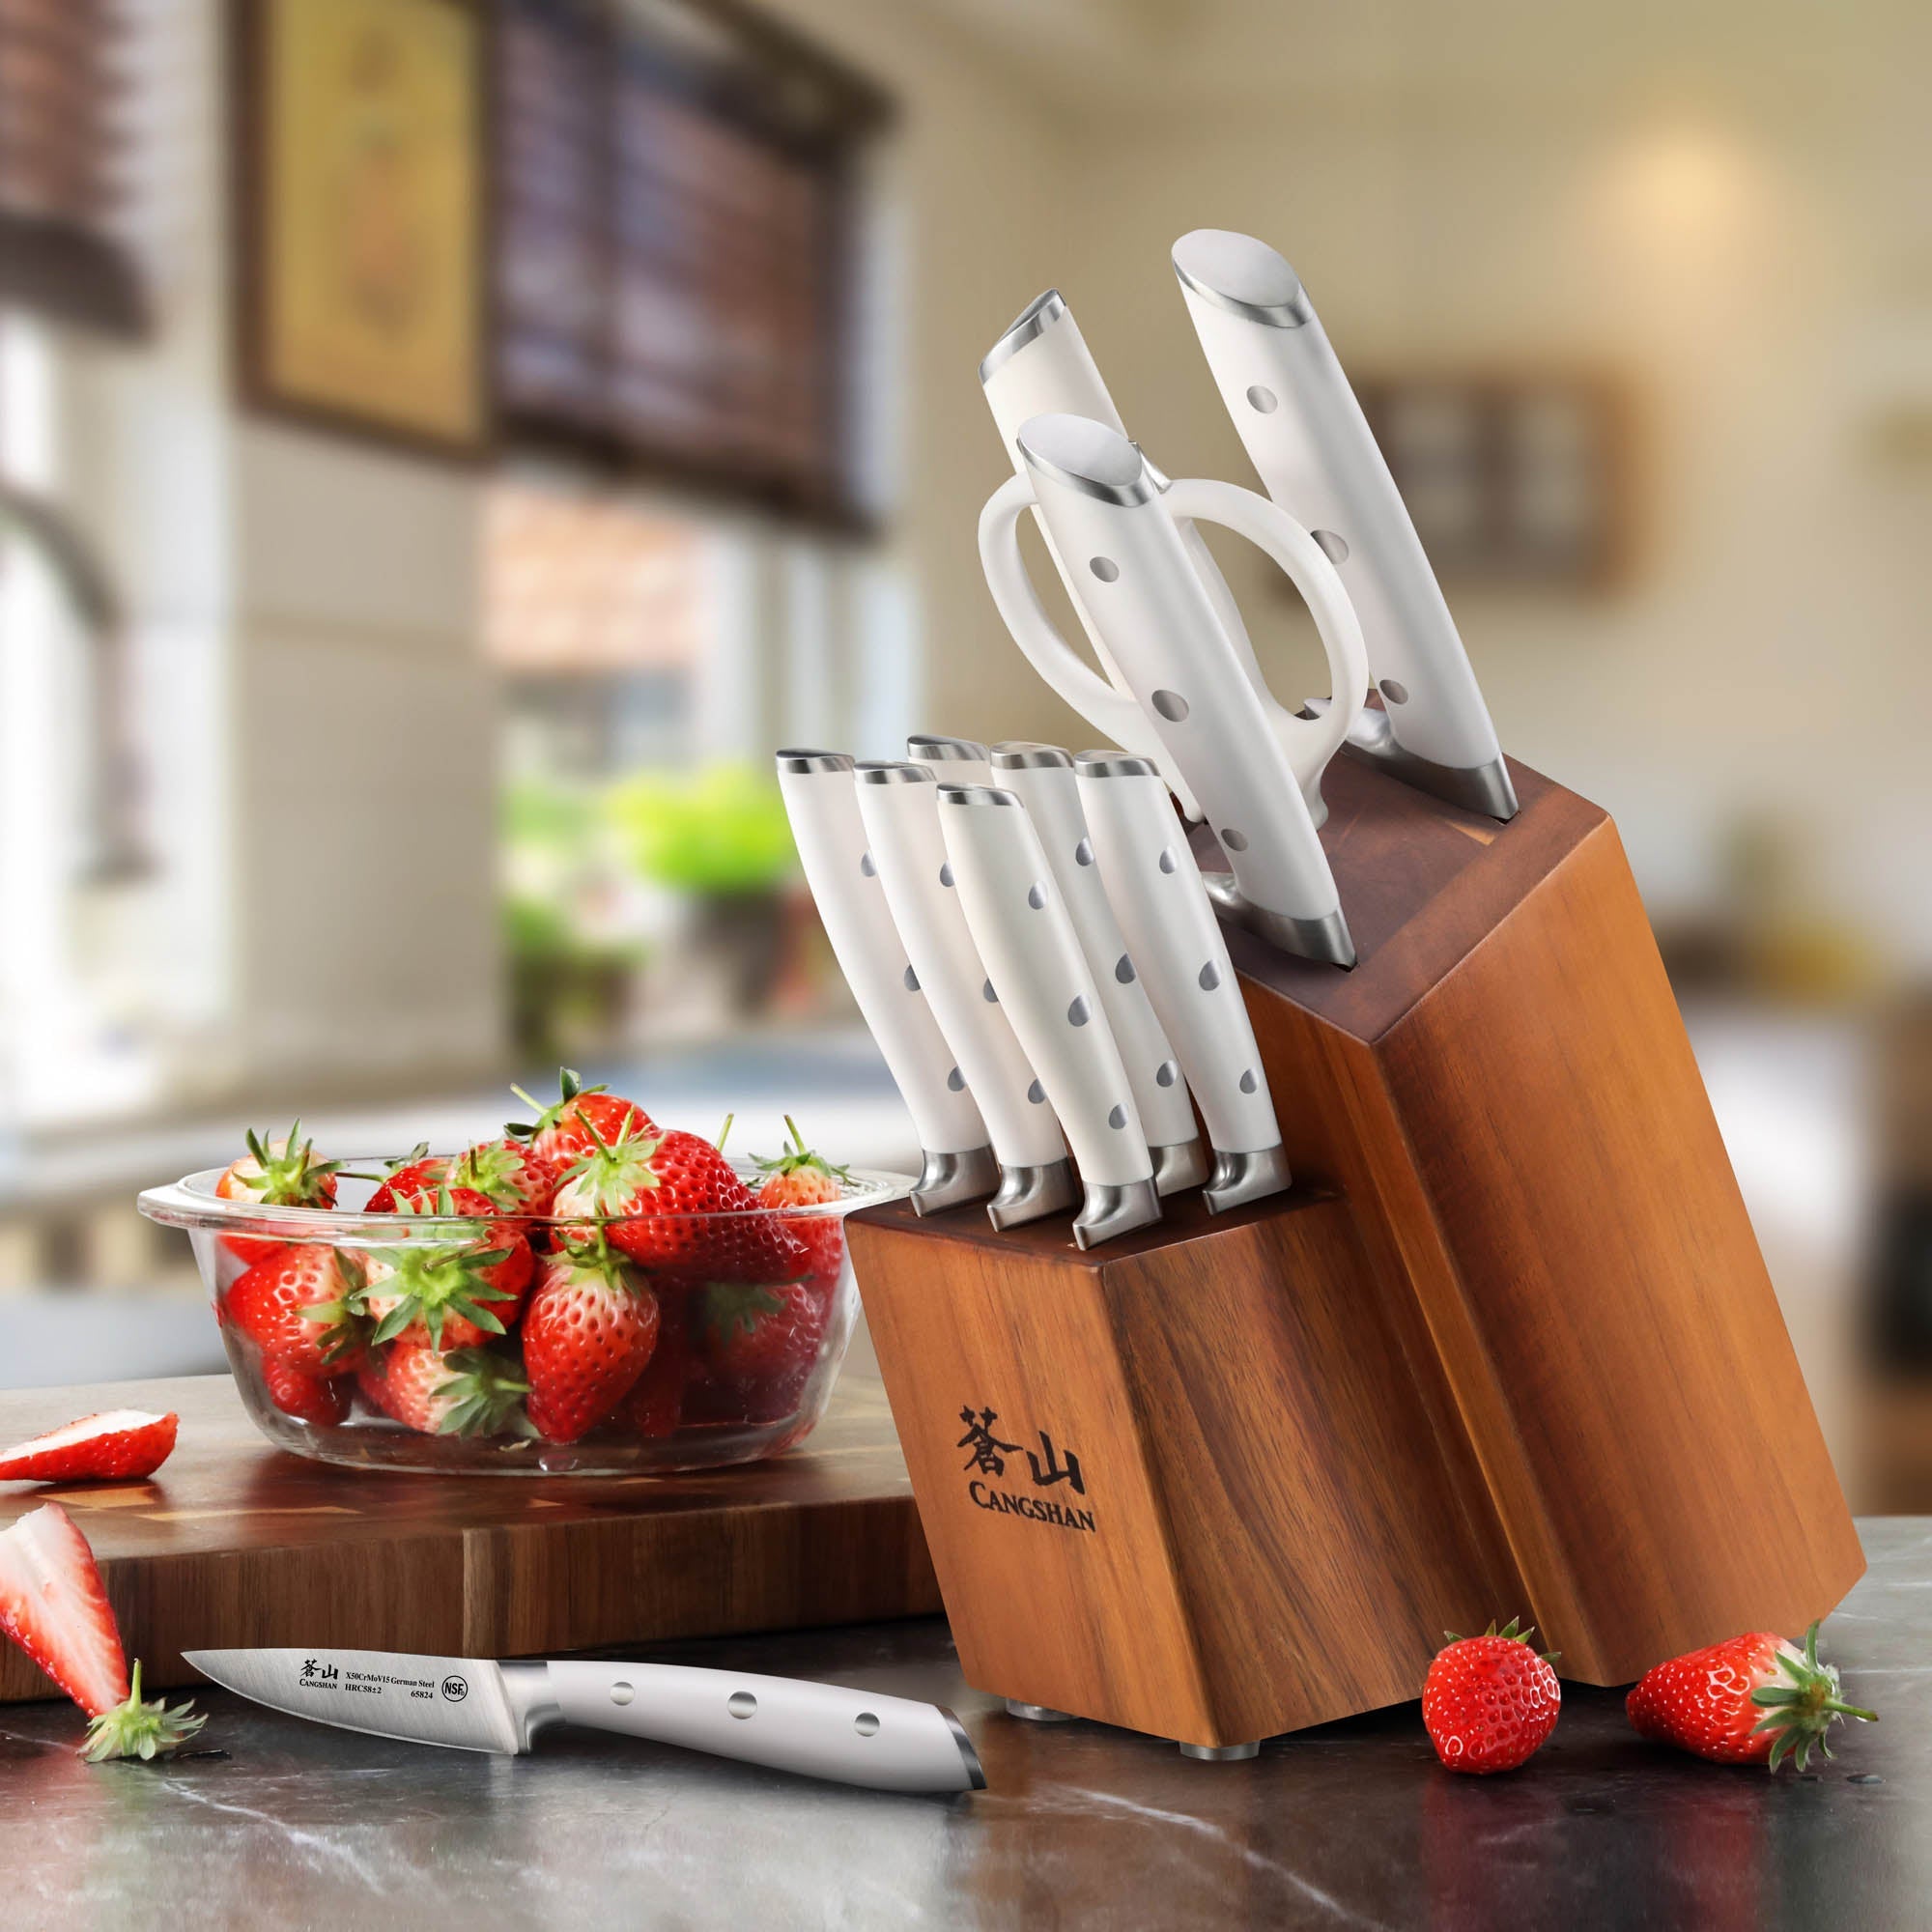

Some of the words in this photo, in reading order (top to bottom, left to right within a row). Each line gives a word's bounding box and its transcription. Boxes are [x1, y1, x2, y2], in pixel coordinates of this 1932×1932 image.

[969, 1480, 1096, 1533] CANGSHAN
[299, 1678, 337, 1690] CANGSHAN
[346, 1671, 390, 1684] X50CrMoV15
[390, 1676, 417, 1687] German
[418, 1679, 435, 1689] Steel
[345, 1683, 382, 1694] HRC58±2
[411, 1690, 434, 1699] 65824
[444, 1682, 464, 1695] NSF
